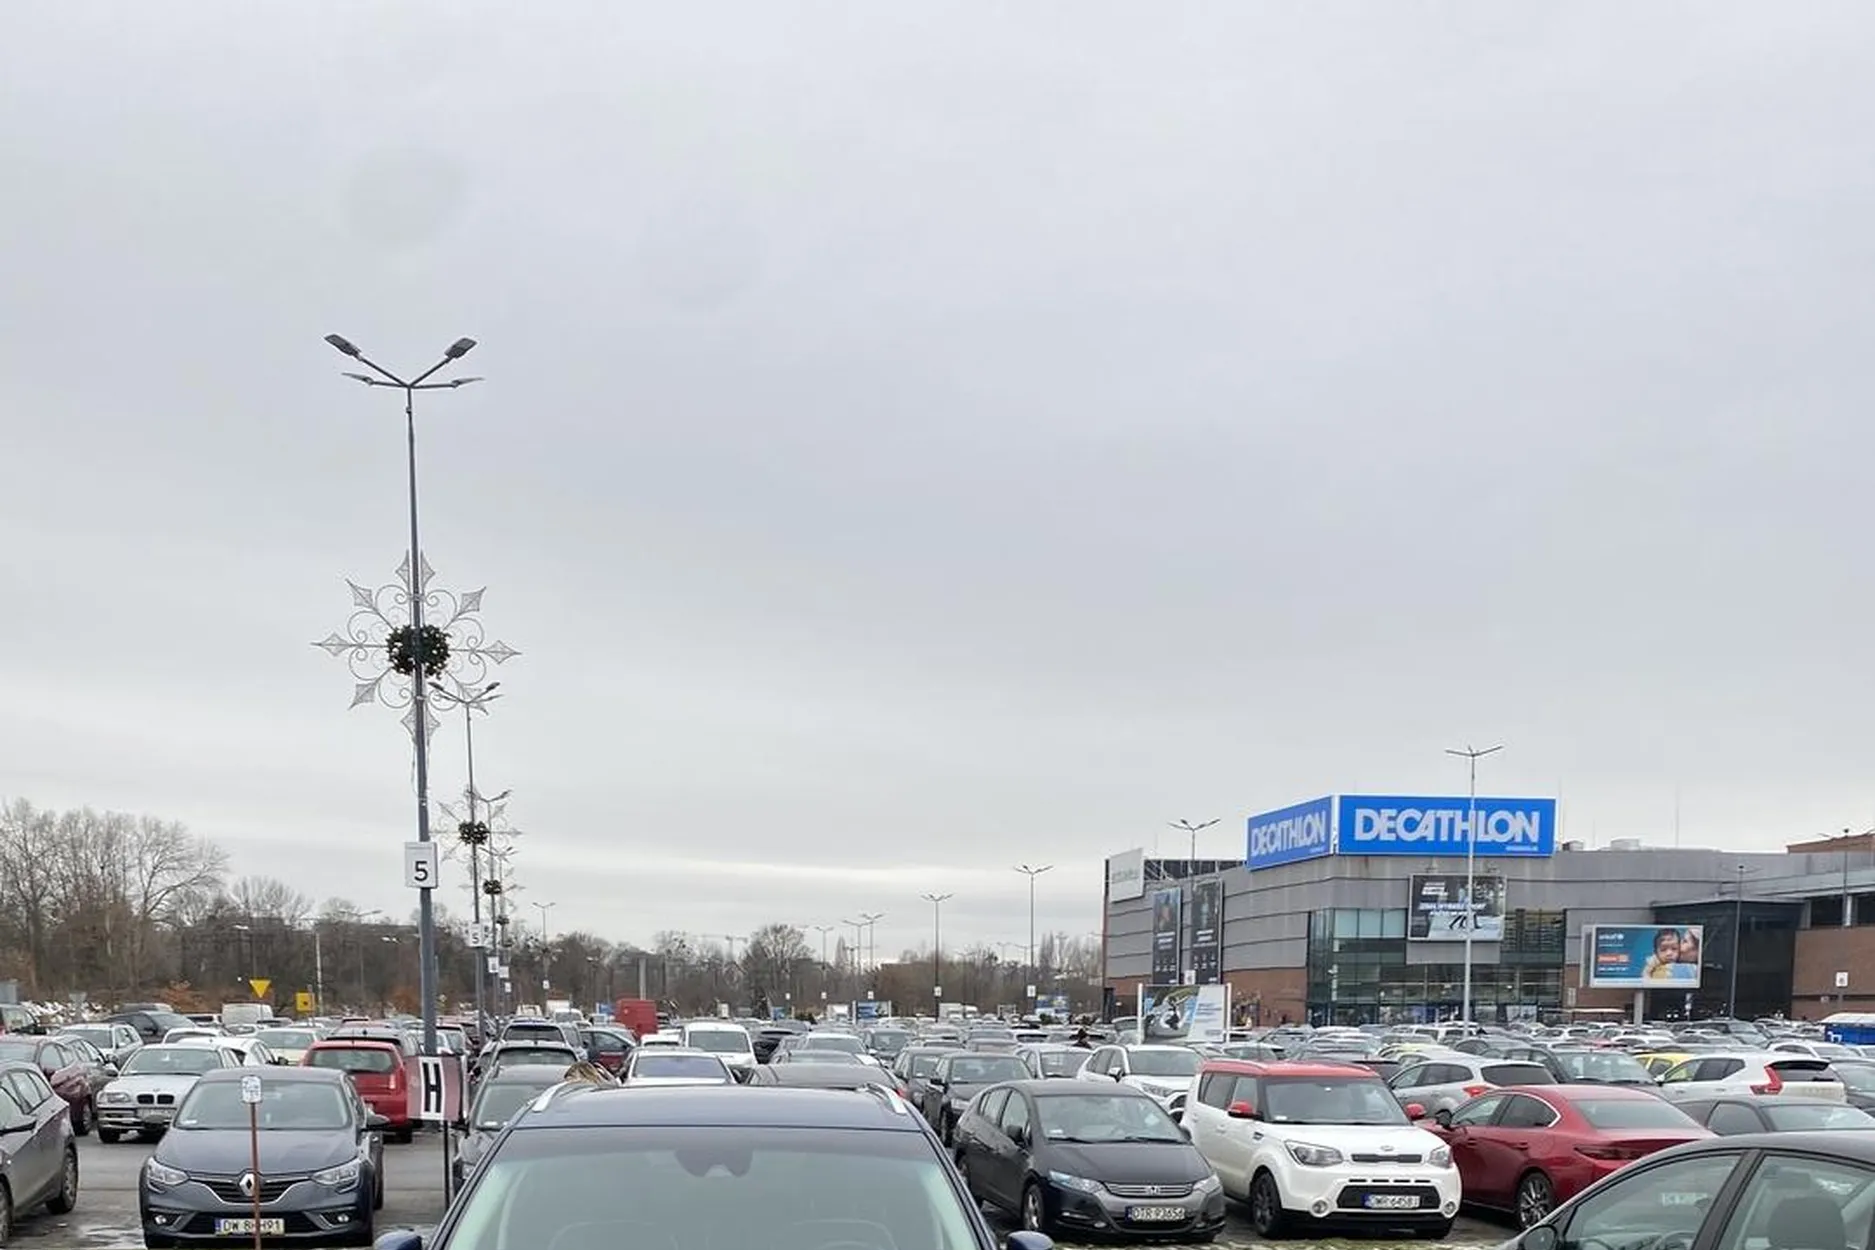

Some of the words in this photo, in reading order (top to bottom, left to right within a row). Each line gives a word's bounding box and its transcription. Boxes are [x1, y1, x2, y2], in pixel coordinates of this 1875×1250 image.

[1251, 810, 1327, 857] DECATHLON
[1355, 808, 1541, 842] DECATHLON
[414, 860, 428, 882] 5
[422, 1062, 442, 1113] H
[224, 1220, 239, 1231] DW
